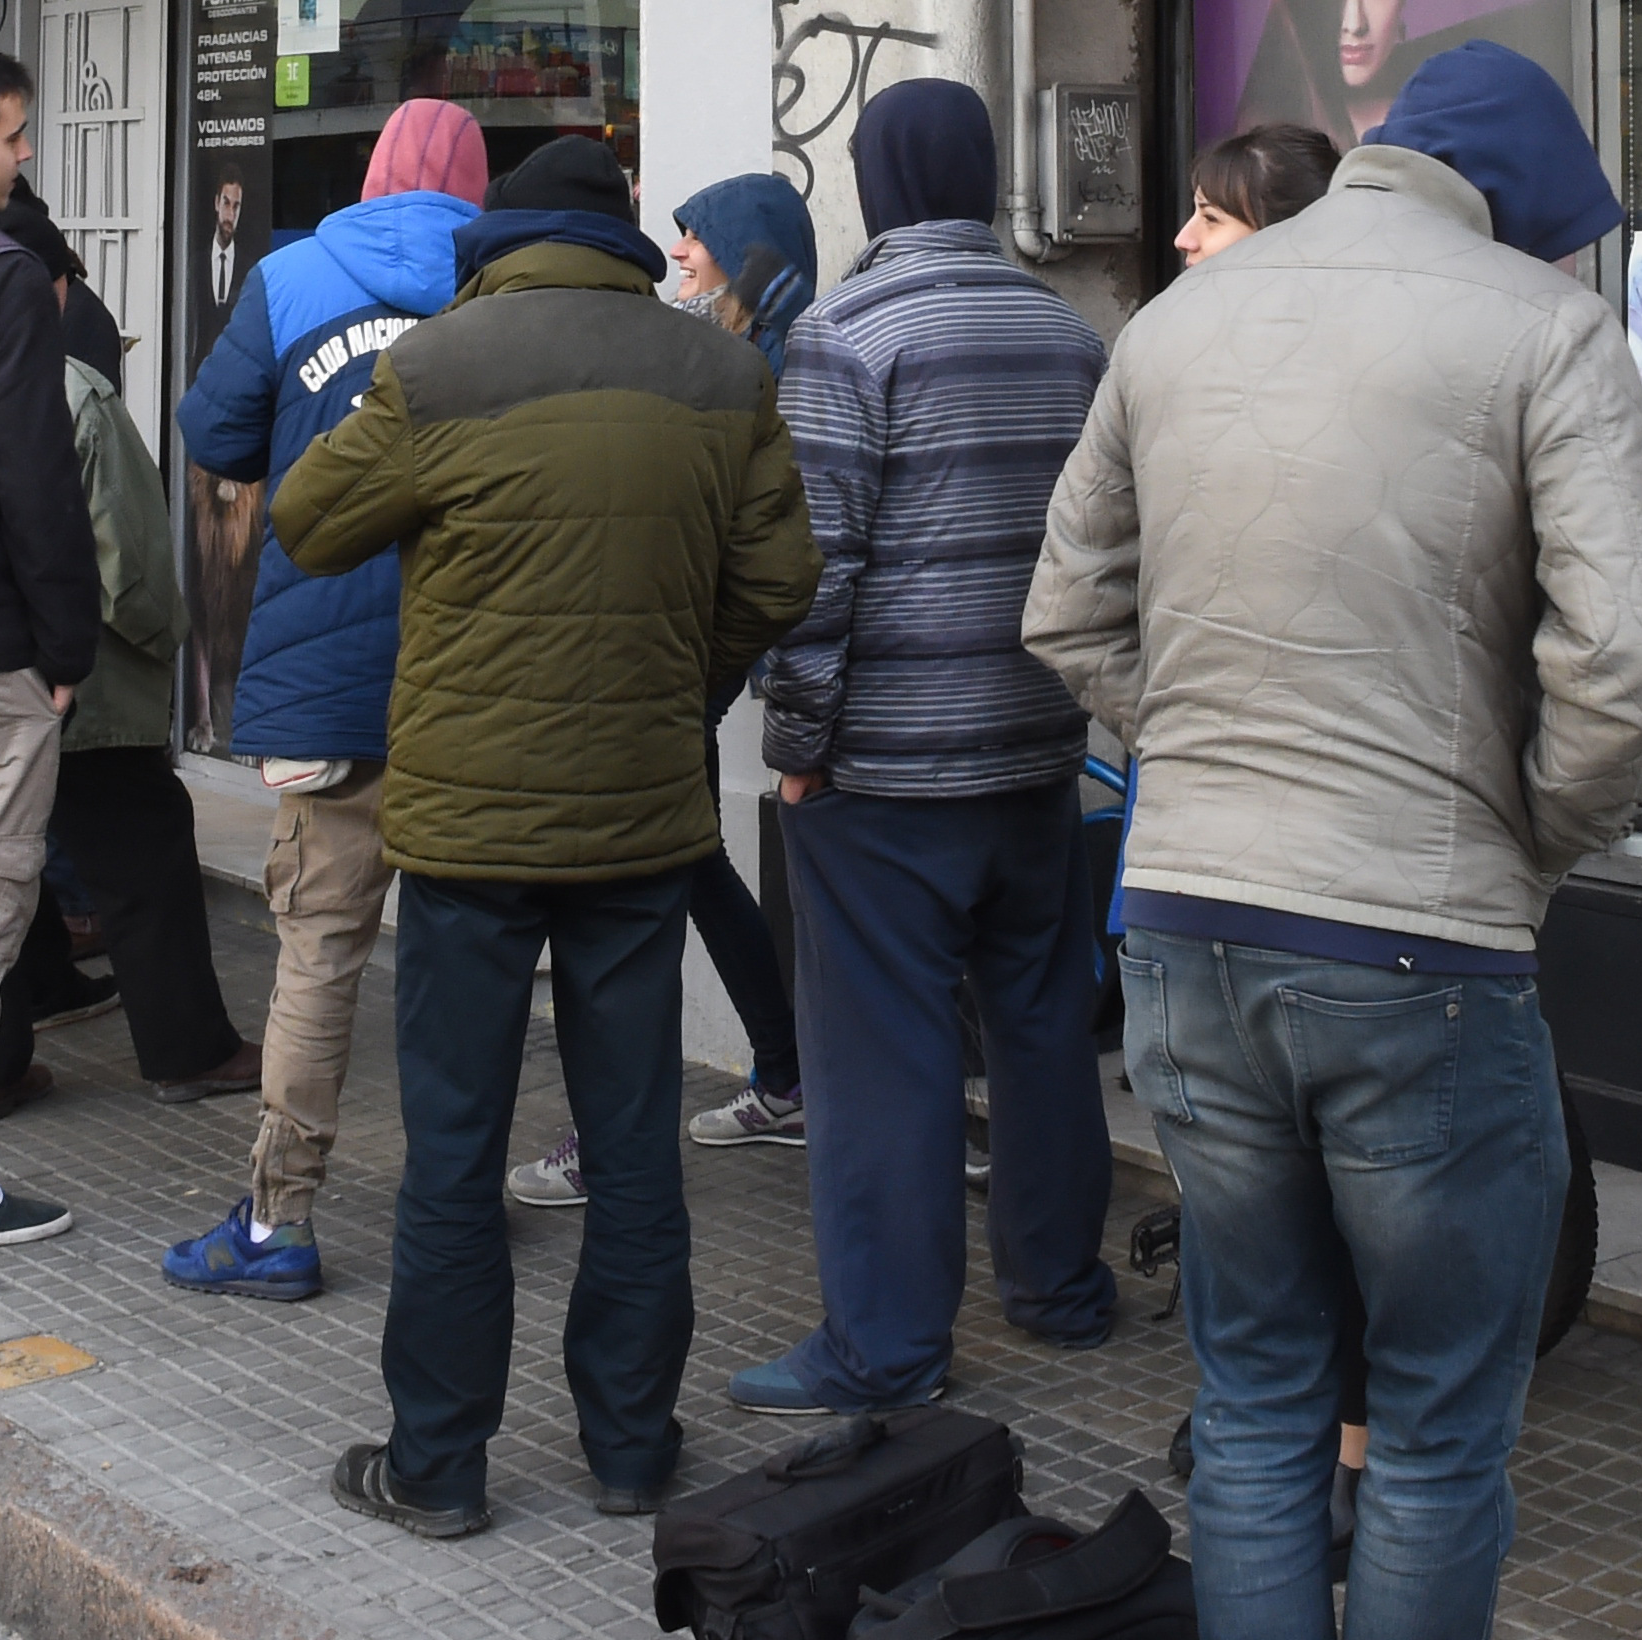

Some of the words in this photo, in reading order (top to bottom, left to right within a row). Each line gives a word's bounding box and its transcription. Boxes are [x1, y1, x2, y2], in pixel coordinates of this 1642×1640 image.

[198, 29, 268, 48] FRAGANCIAS
[197, 49, 252, 65] INTENSAS
[197, 64, 267, 84] PROTECCIÓN
[198, 118, 265, 134] VOLVAMOS
[197, 138, 204, 148] A
[298, 334, 349, 394] CLUB
